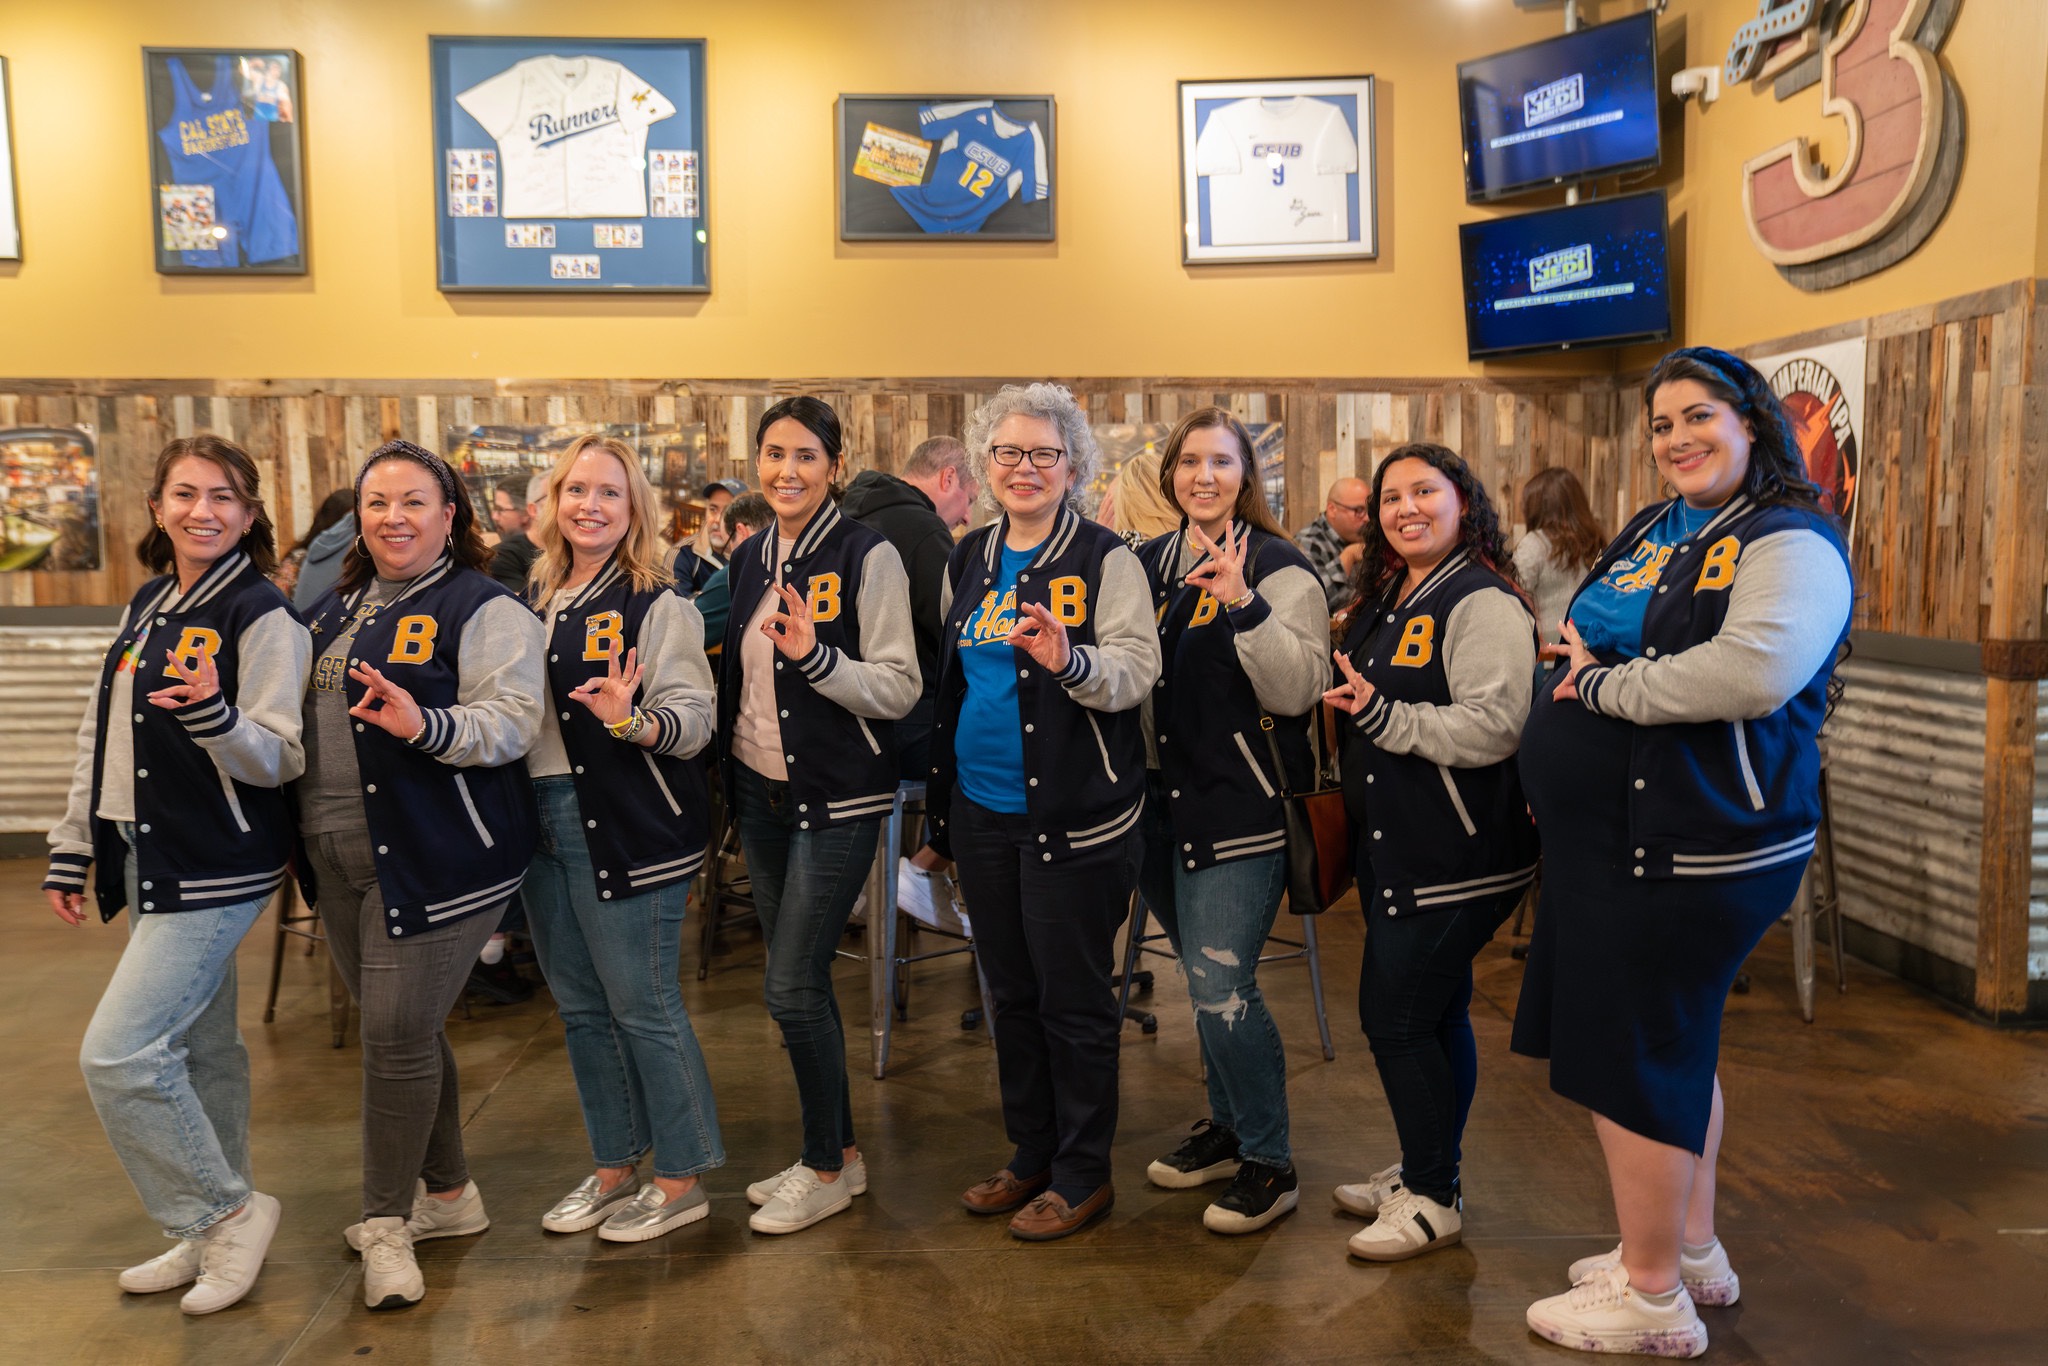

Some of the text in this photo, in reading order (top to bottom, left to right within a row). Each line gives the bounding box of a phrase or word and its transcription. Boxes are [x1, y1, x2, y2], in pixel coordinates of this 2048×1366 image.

[529, 103, 618, 142] Runners
[964, 141, 1011, 178] CSUB
[1252, 142, 1303, 158] CSUB
[958, 156, 995, 199] 12
[1535, 259, 1585, 281] JEDI
[1773, 360, 1850, 450] IMPERIAL IPA
[1693, 535, 1741, 597] B
[808, 572, 841, 623] B
[1049, 576, 1087, 627] B
[163, 626, 223, 681] B
[387, 615, 438, 665] B
[582, 610, 624, 661] B
[1390, 614, 1435, 668] B
